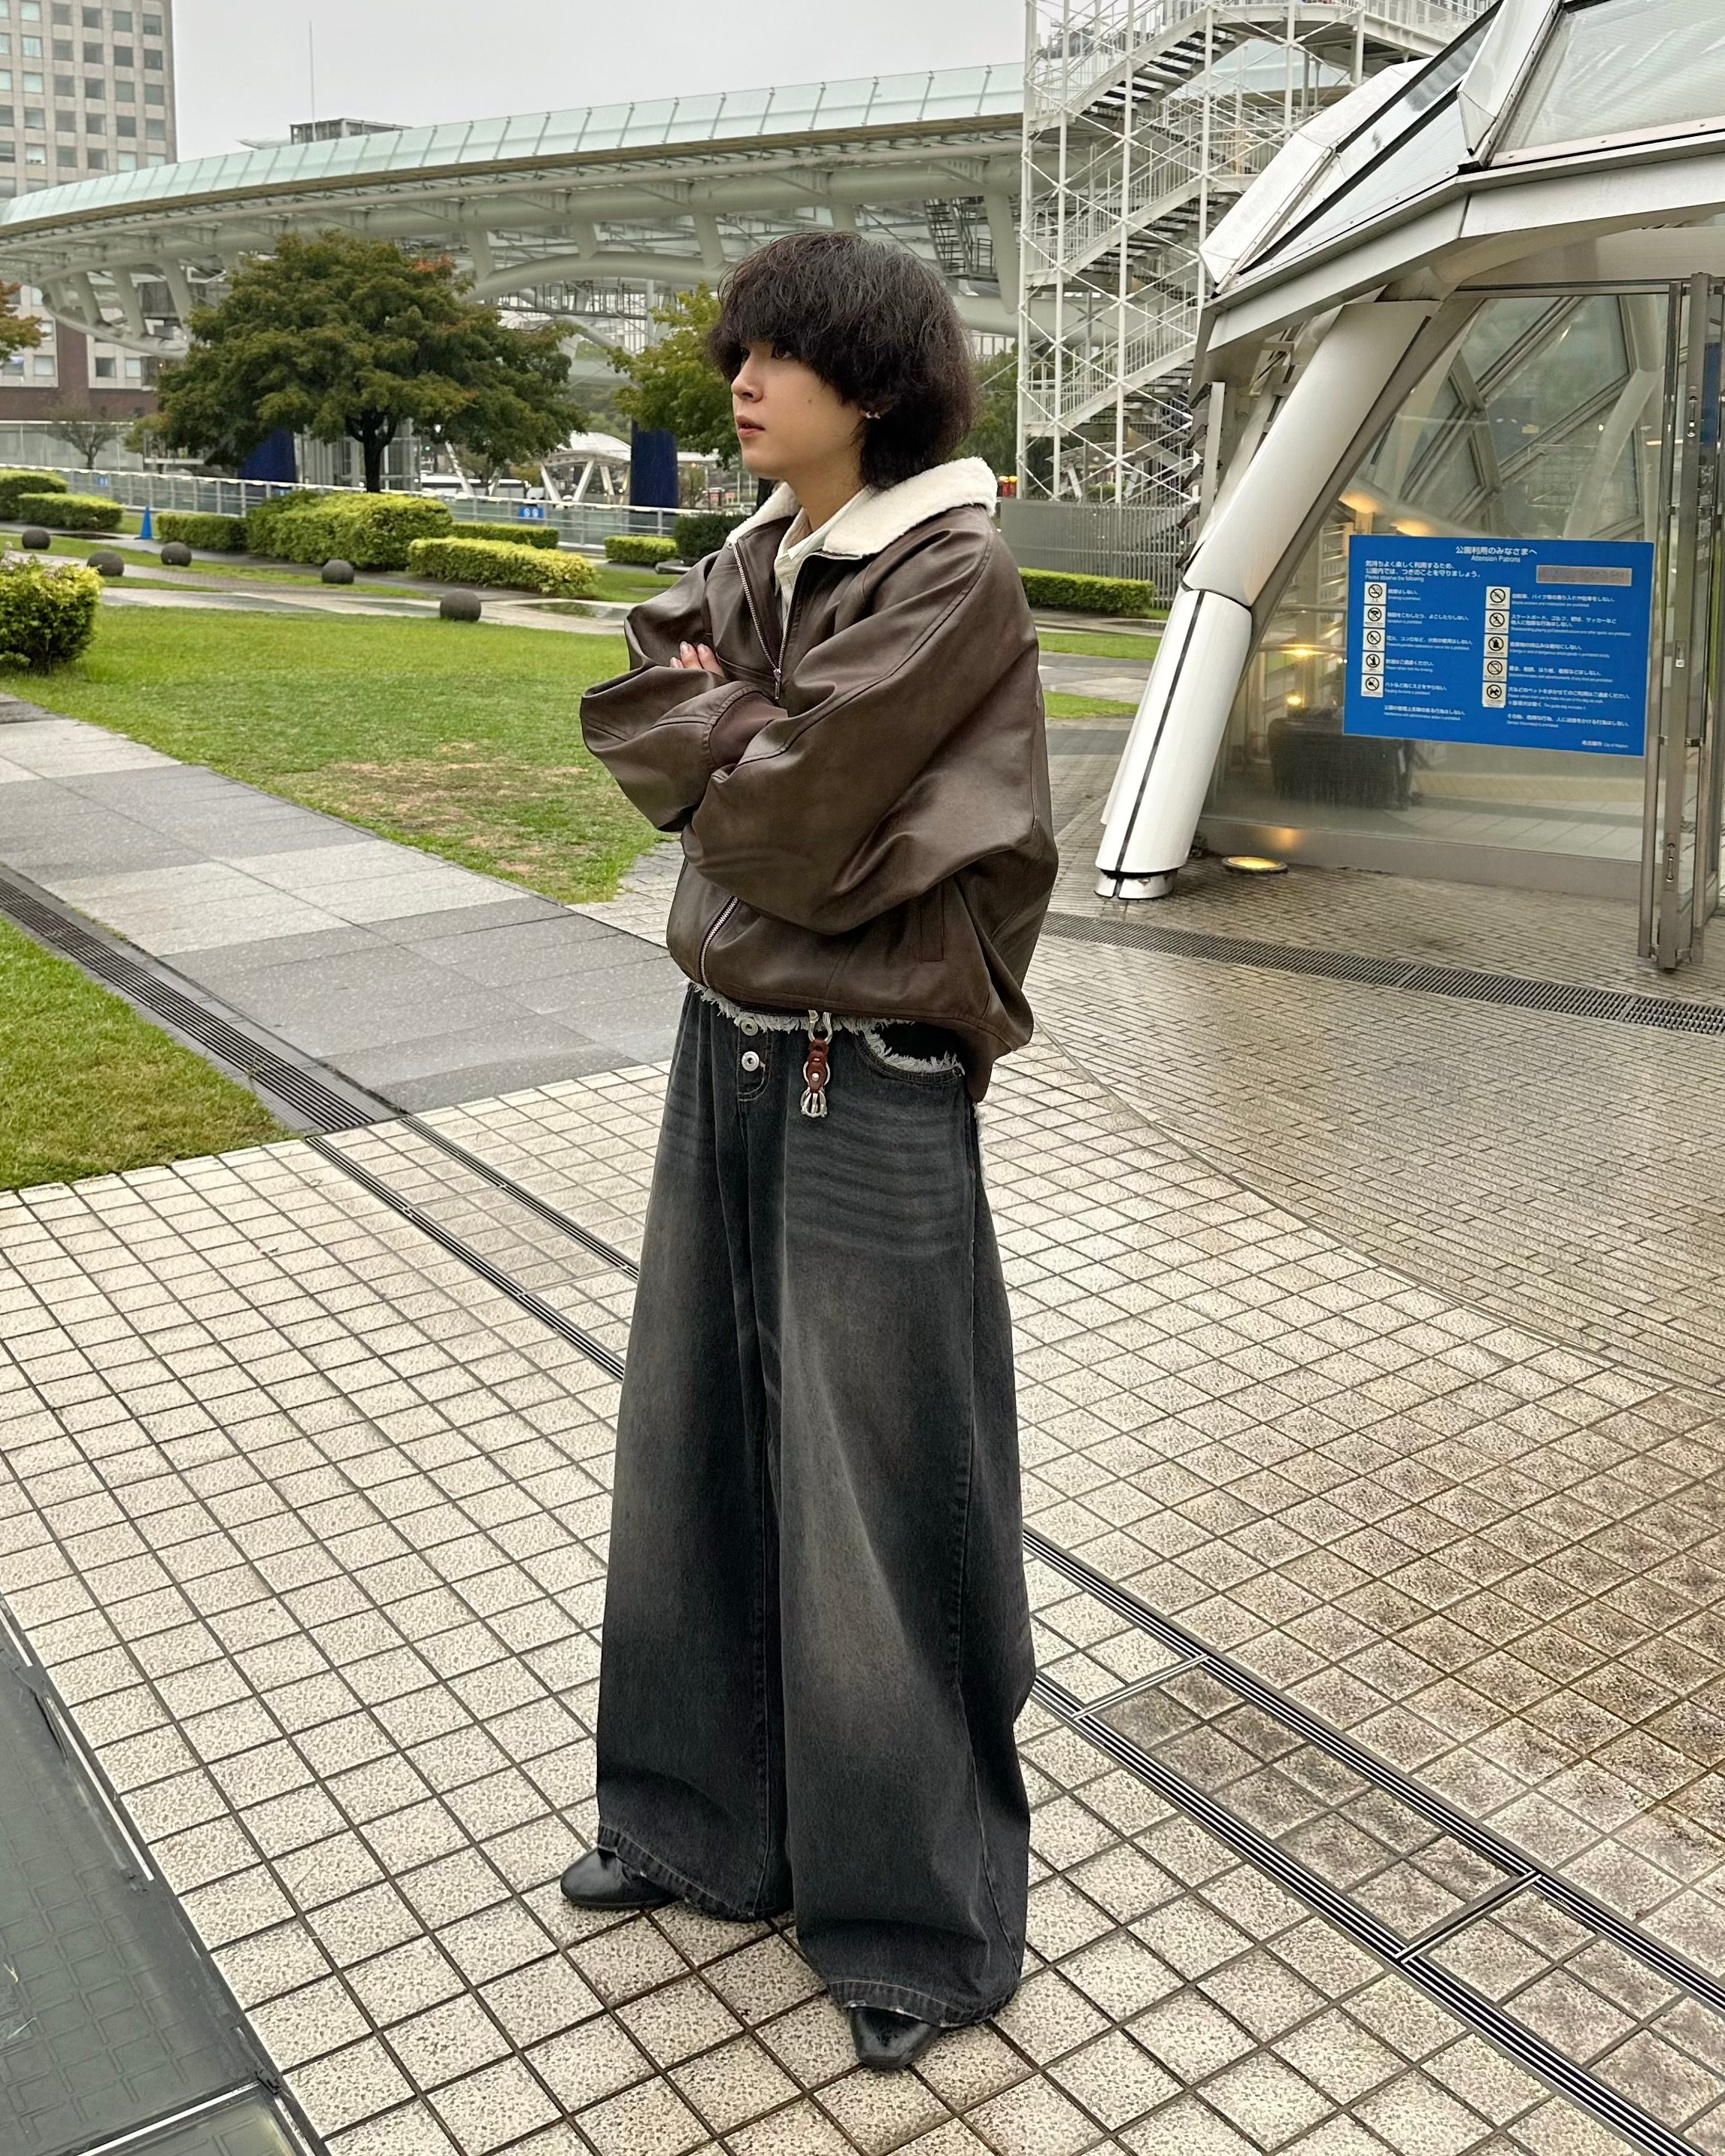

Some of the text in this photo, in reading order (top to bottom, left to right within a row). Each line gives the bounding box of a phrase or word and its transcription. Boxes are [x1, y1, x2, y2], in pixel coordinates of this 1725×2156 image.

[1456, 546, 1537, 556] 公園利用のみなさまへ
